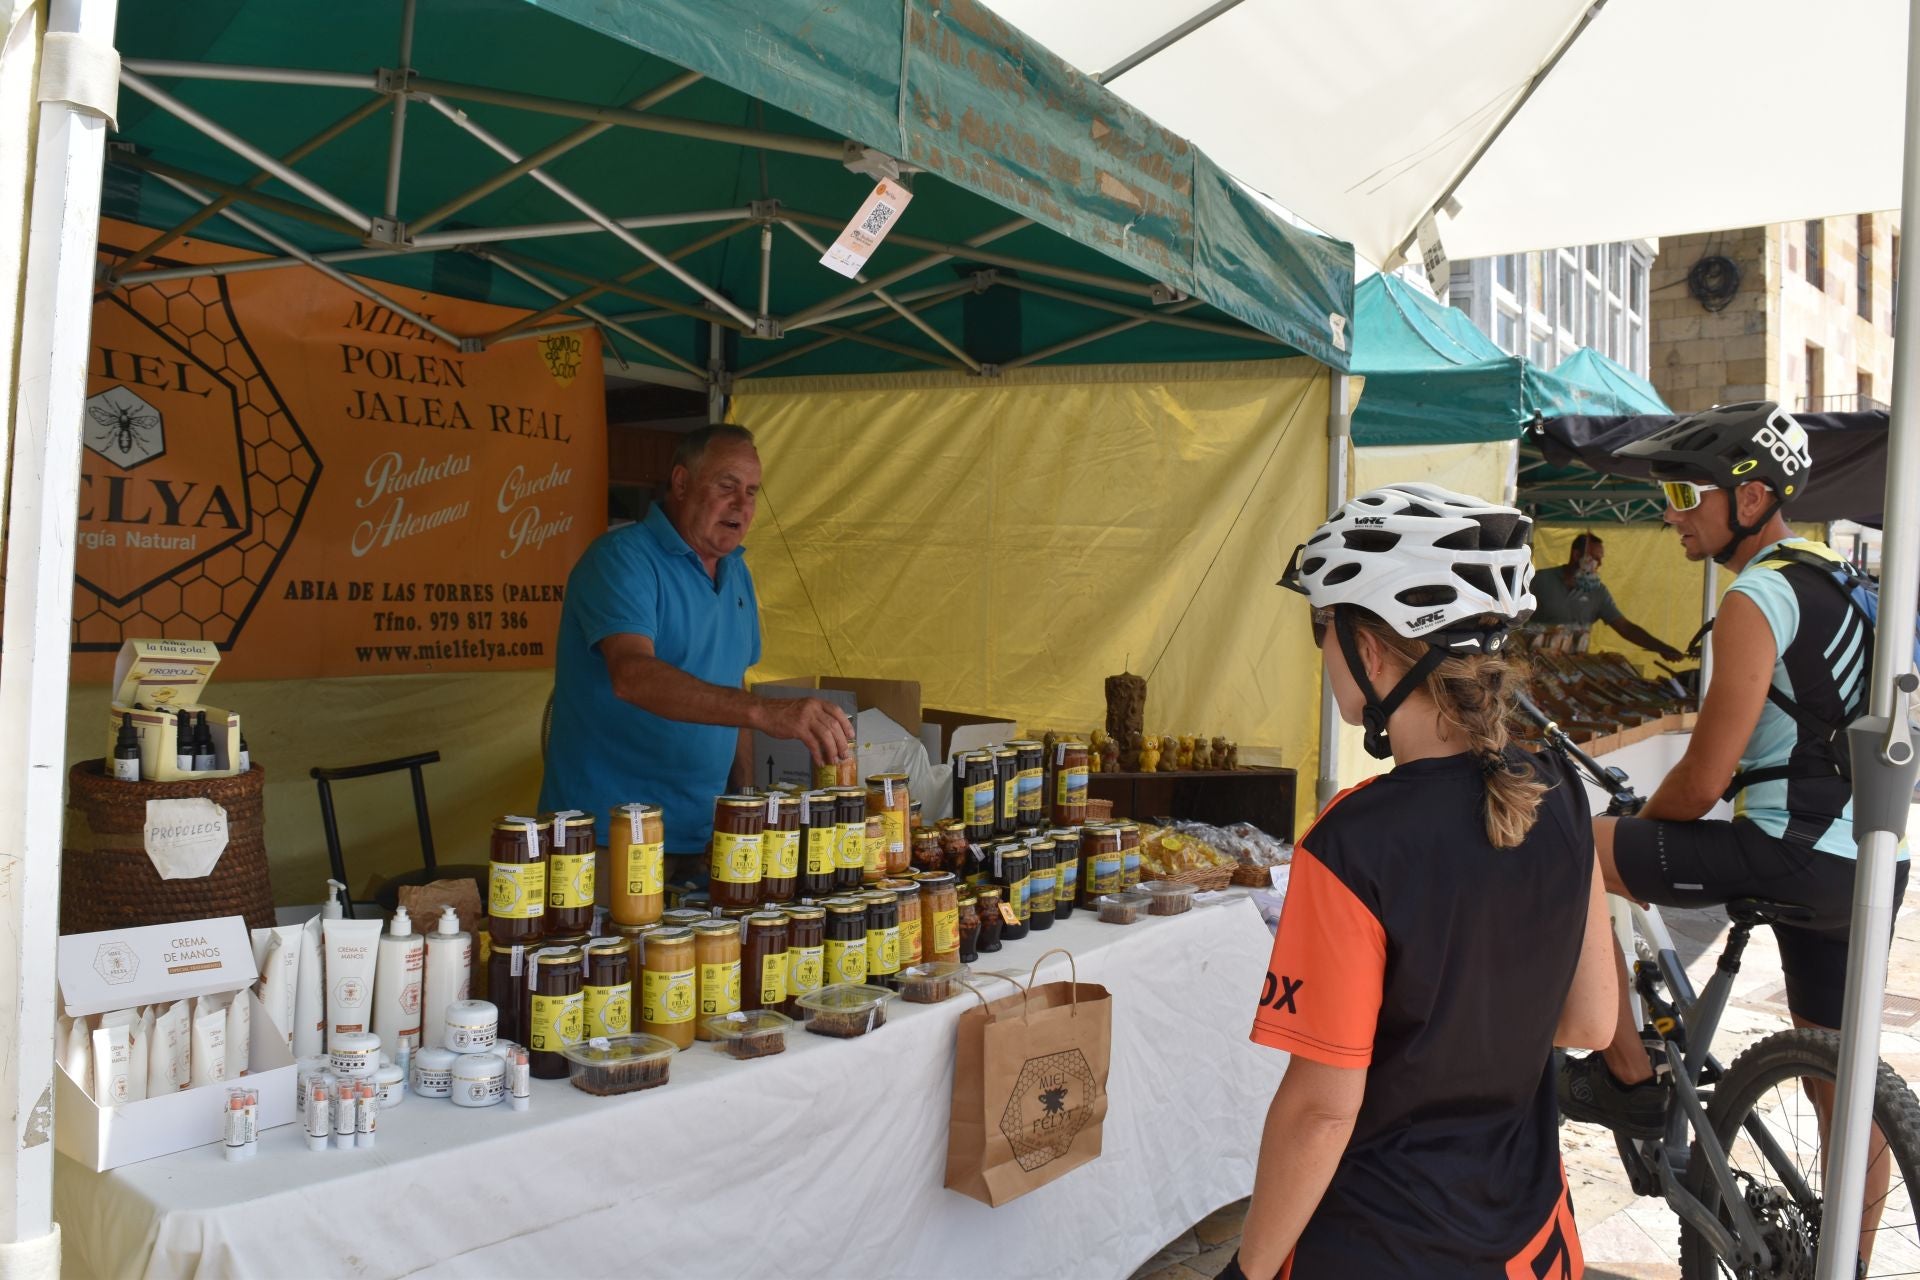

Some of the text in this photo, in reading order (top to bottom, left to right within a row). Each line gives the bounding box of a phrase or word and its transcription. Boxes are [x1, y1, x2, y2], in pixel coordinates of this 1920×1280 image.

[343, 301, 437, 344] MIEL
[92, 347, 212, 398] IEL
[339, 344, 467, 388] POLEN
[346, 389, 572, 443] JALEA REAL
[355, 452, 471, 508] Productos
[497, 462, 573, 513] Cosecha
[351, 497, 470, 557] Artesanos
[500, 505, 574, 559] Propia
[126, 531, 196, 550] Natural
[284, 580, 564, 604] ABIA DE LAS TORRES (PALEN
[373, 611, 528, 632] Tfno. 979 817 386
[1406, 609, 1445, 629] WRC
[147, 643, 158, 651] la
[355, 638, 544, 662] www.mielfelya.com
[148, 667, 194, 676] PROPOLI
[171, 936, 208, 949] CREMA
[164, 947, 221, 963] DE MANOS
[1039, 1072, 1068, 1090] MIEL
[1033, 1111, 1072, 1134] FELYA
